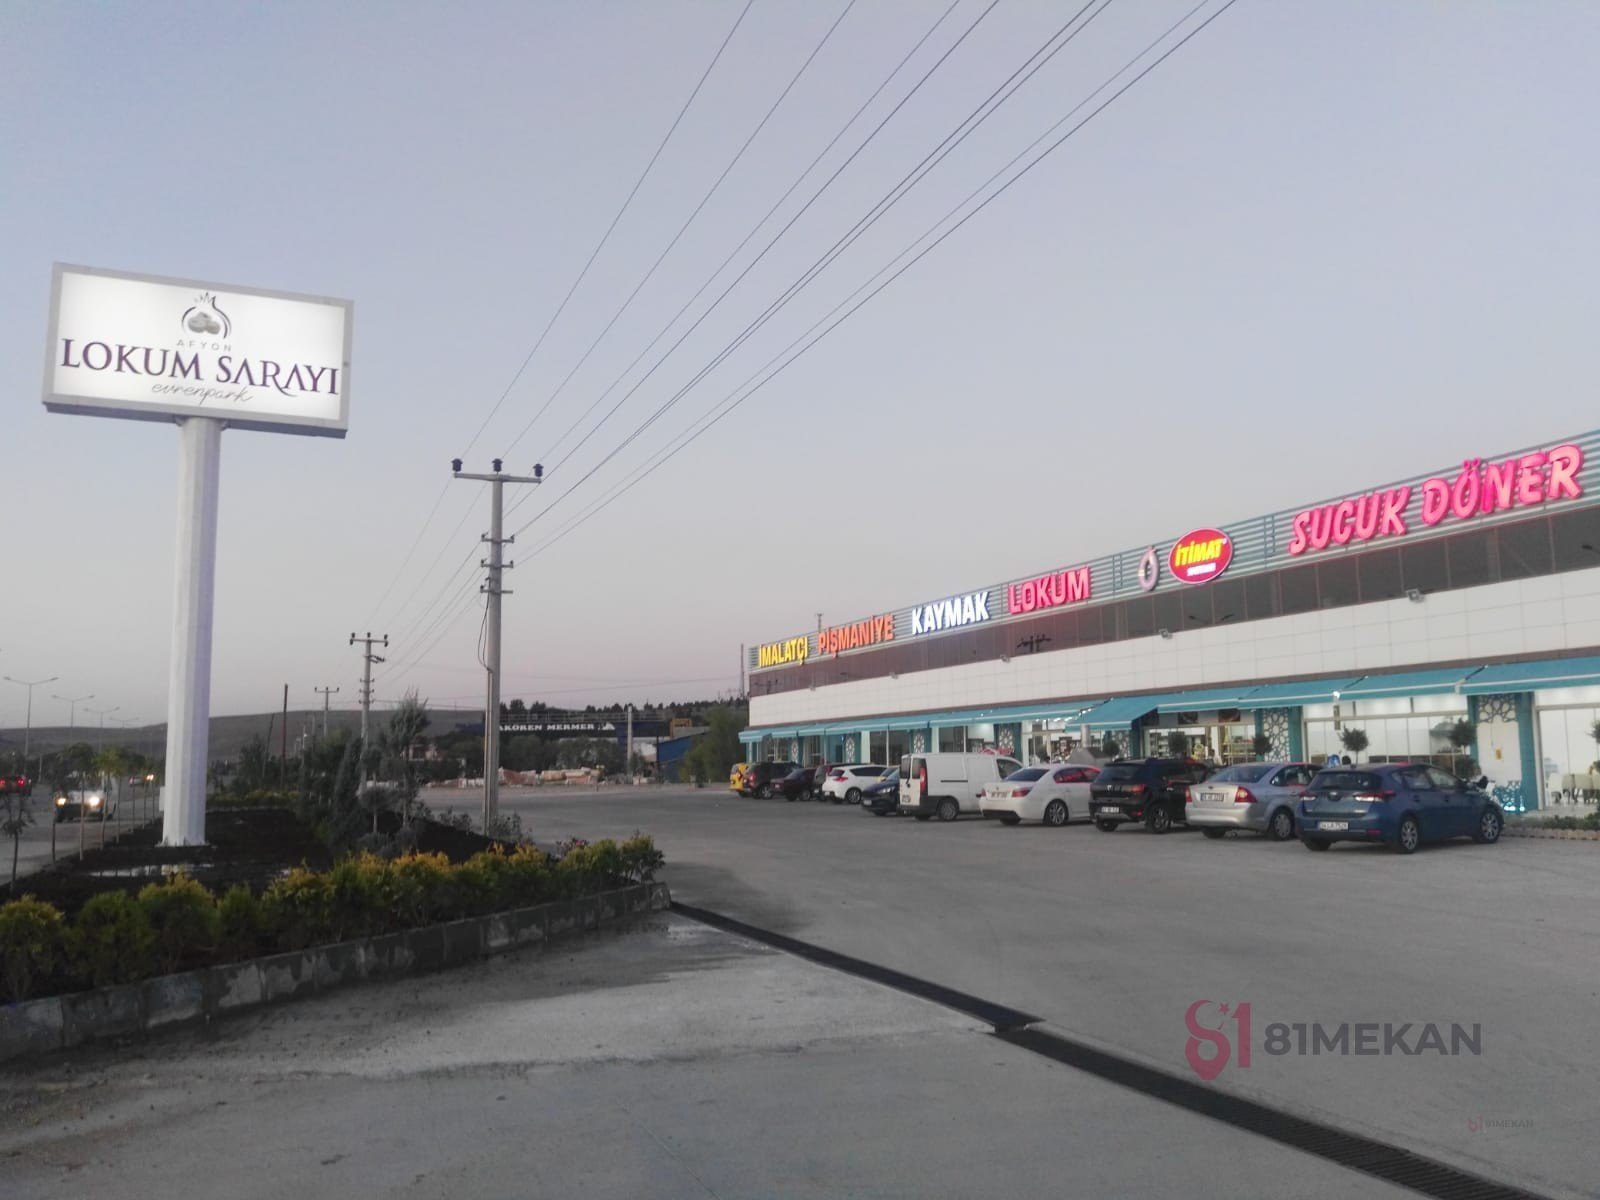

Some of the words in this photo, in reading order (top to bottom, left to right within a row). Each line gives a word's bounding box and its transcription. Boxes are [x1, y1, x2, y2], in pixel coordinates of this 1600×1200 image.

[61, 338, 205, 381] LOKUM
[215, 355, 340, 397] SARAYI
[176, 339, 232, 352] AFYON
[1289, 486, 1412, 555] SUCUK
[1421, 444, 1584, 527] DÖNER
[911, 591, 990, 635] KAYMAK
[1008, 566, 1091, 615] LOKUM
[817, 613, 895, 659] PİŞMANİYE
[546, 723, 594, 731] MERMER
